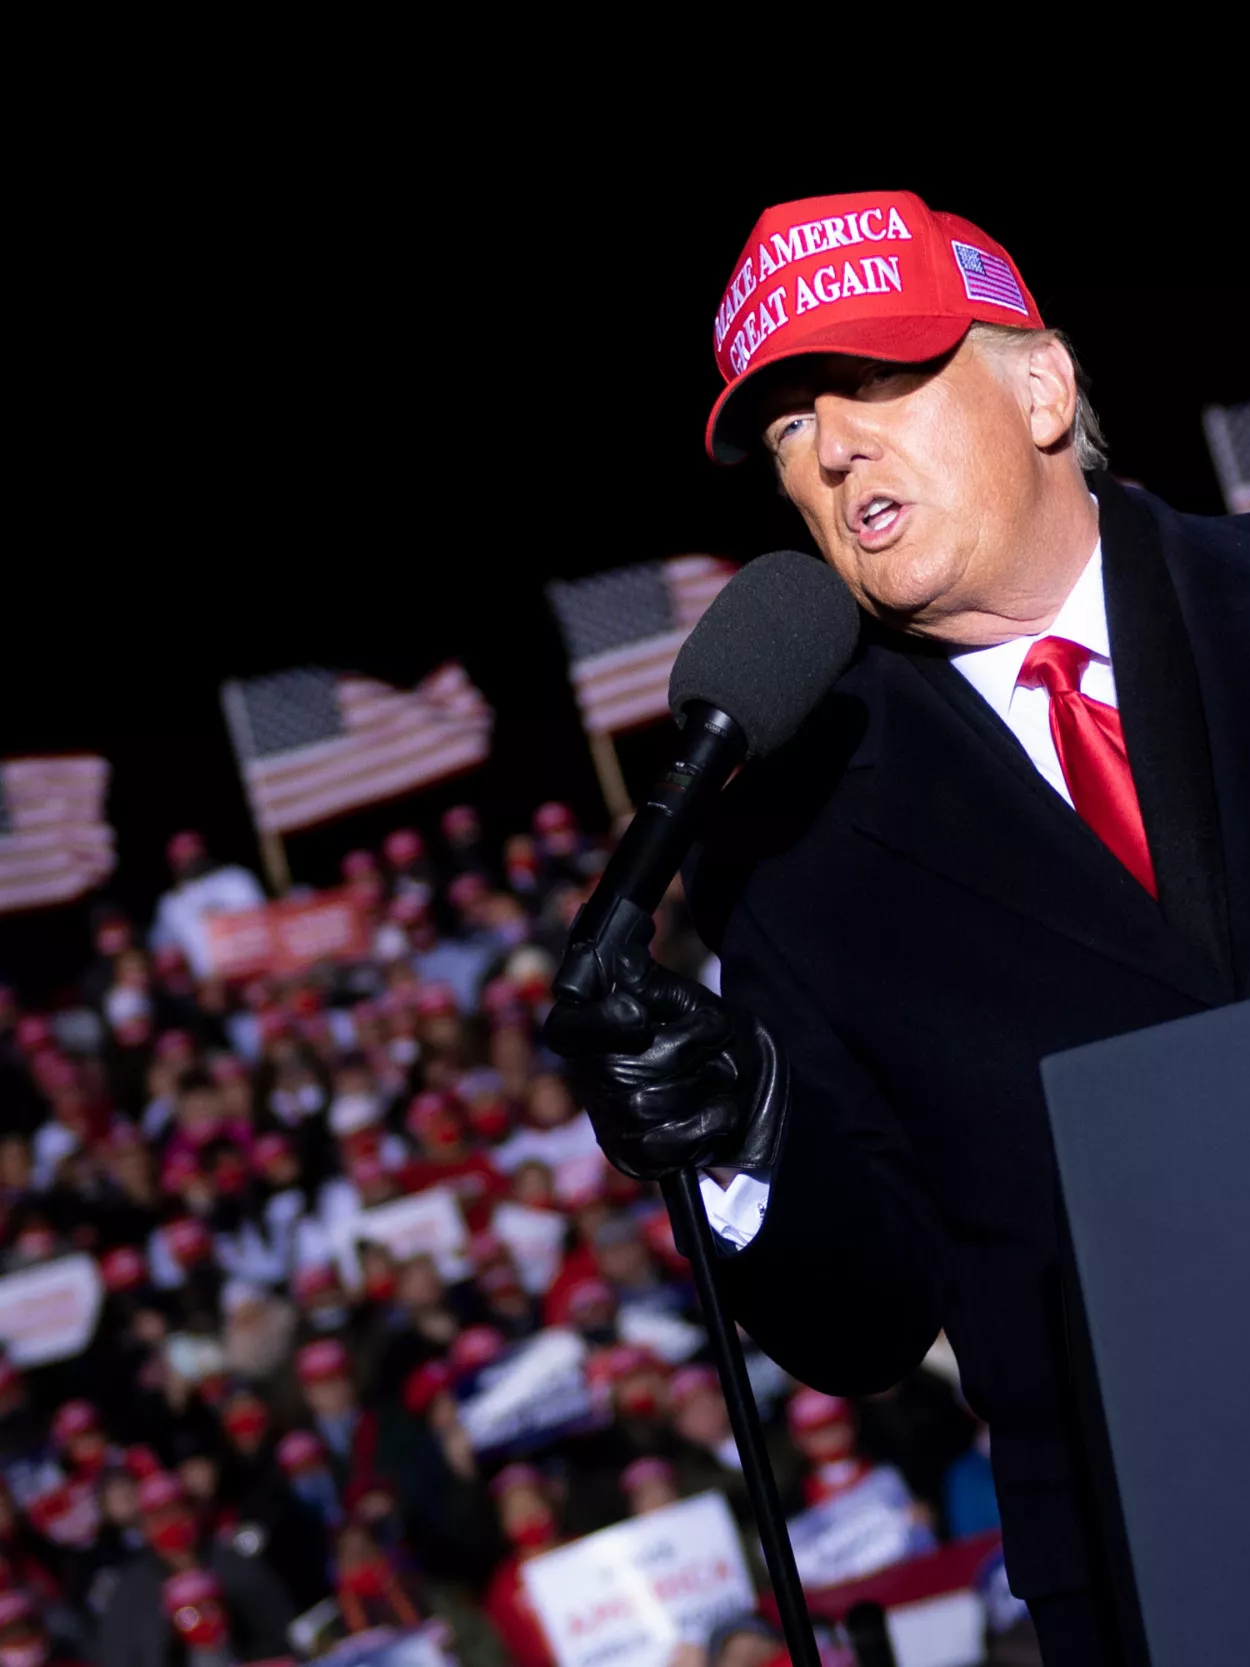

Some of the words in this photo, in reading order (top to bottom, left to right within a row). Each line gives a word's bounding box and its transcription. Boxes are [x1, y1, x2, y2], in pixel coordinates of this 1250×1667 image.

[714, 257, 757, 353] MAKE
[758, 207, 912, 283] AMERICA
[729, 286, 789, 377] GREAT
[795, 256, 902, 315] AGAIN
